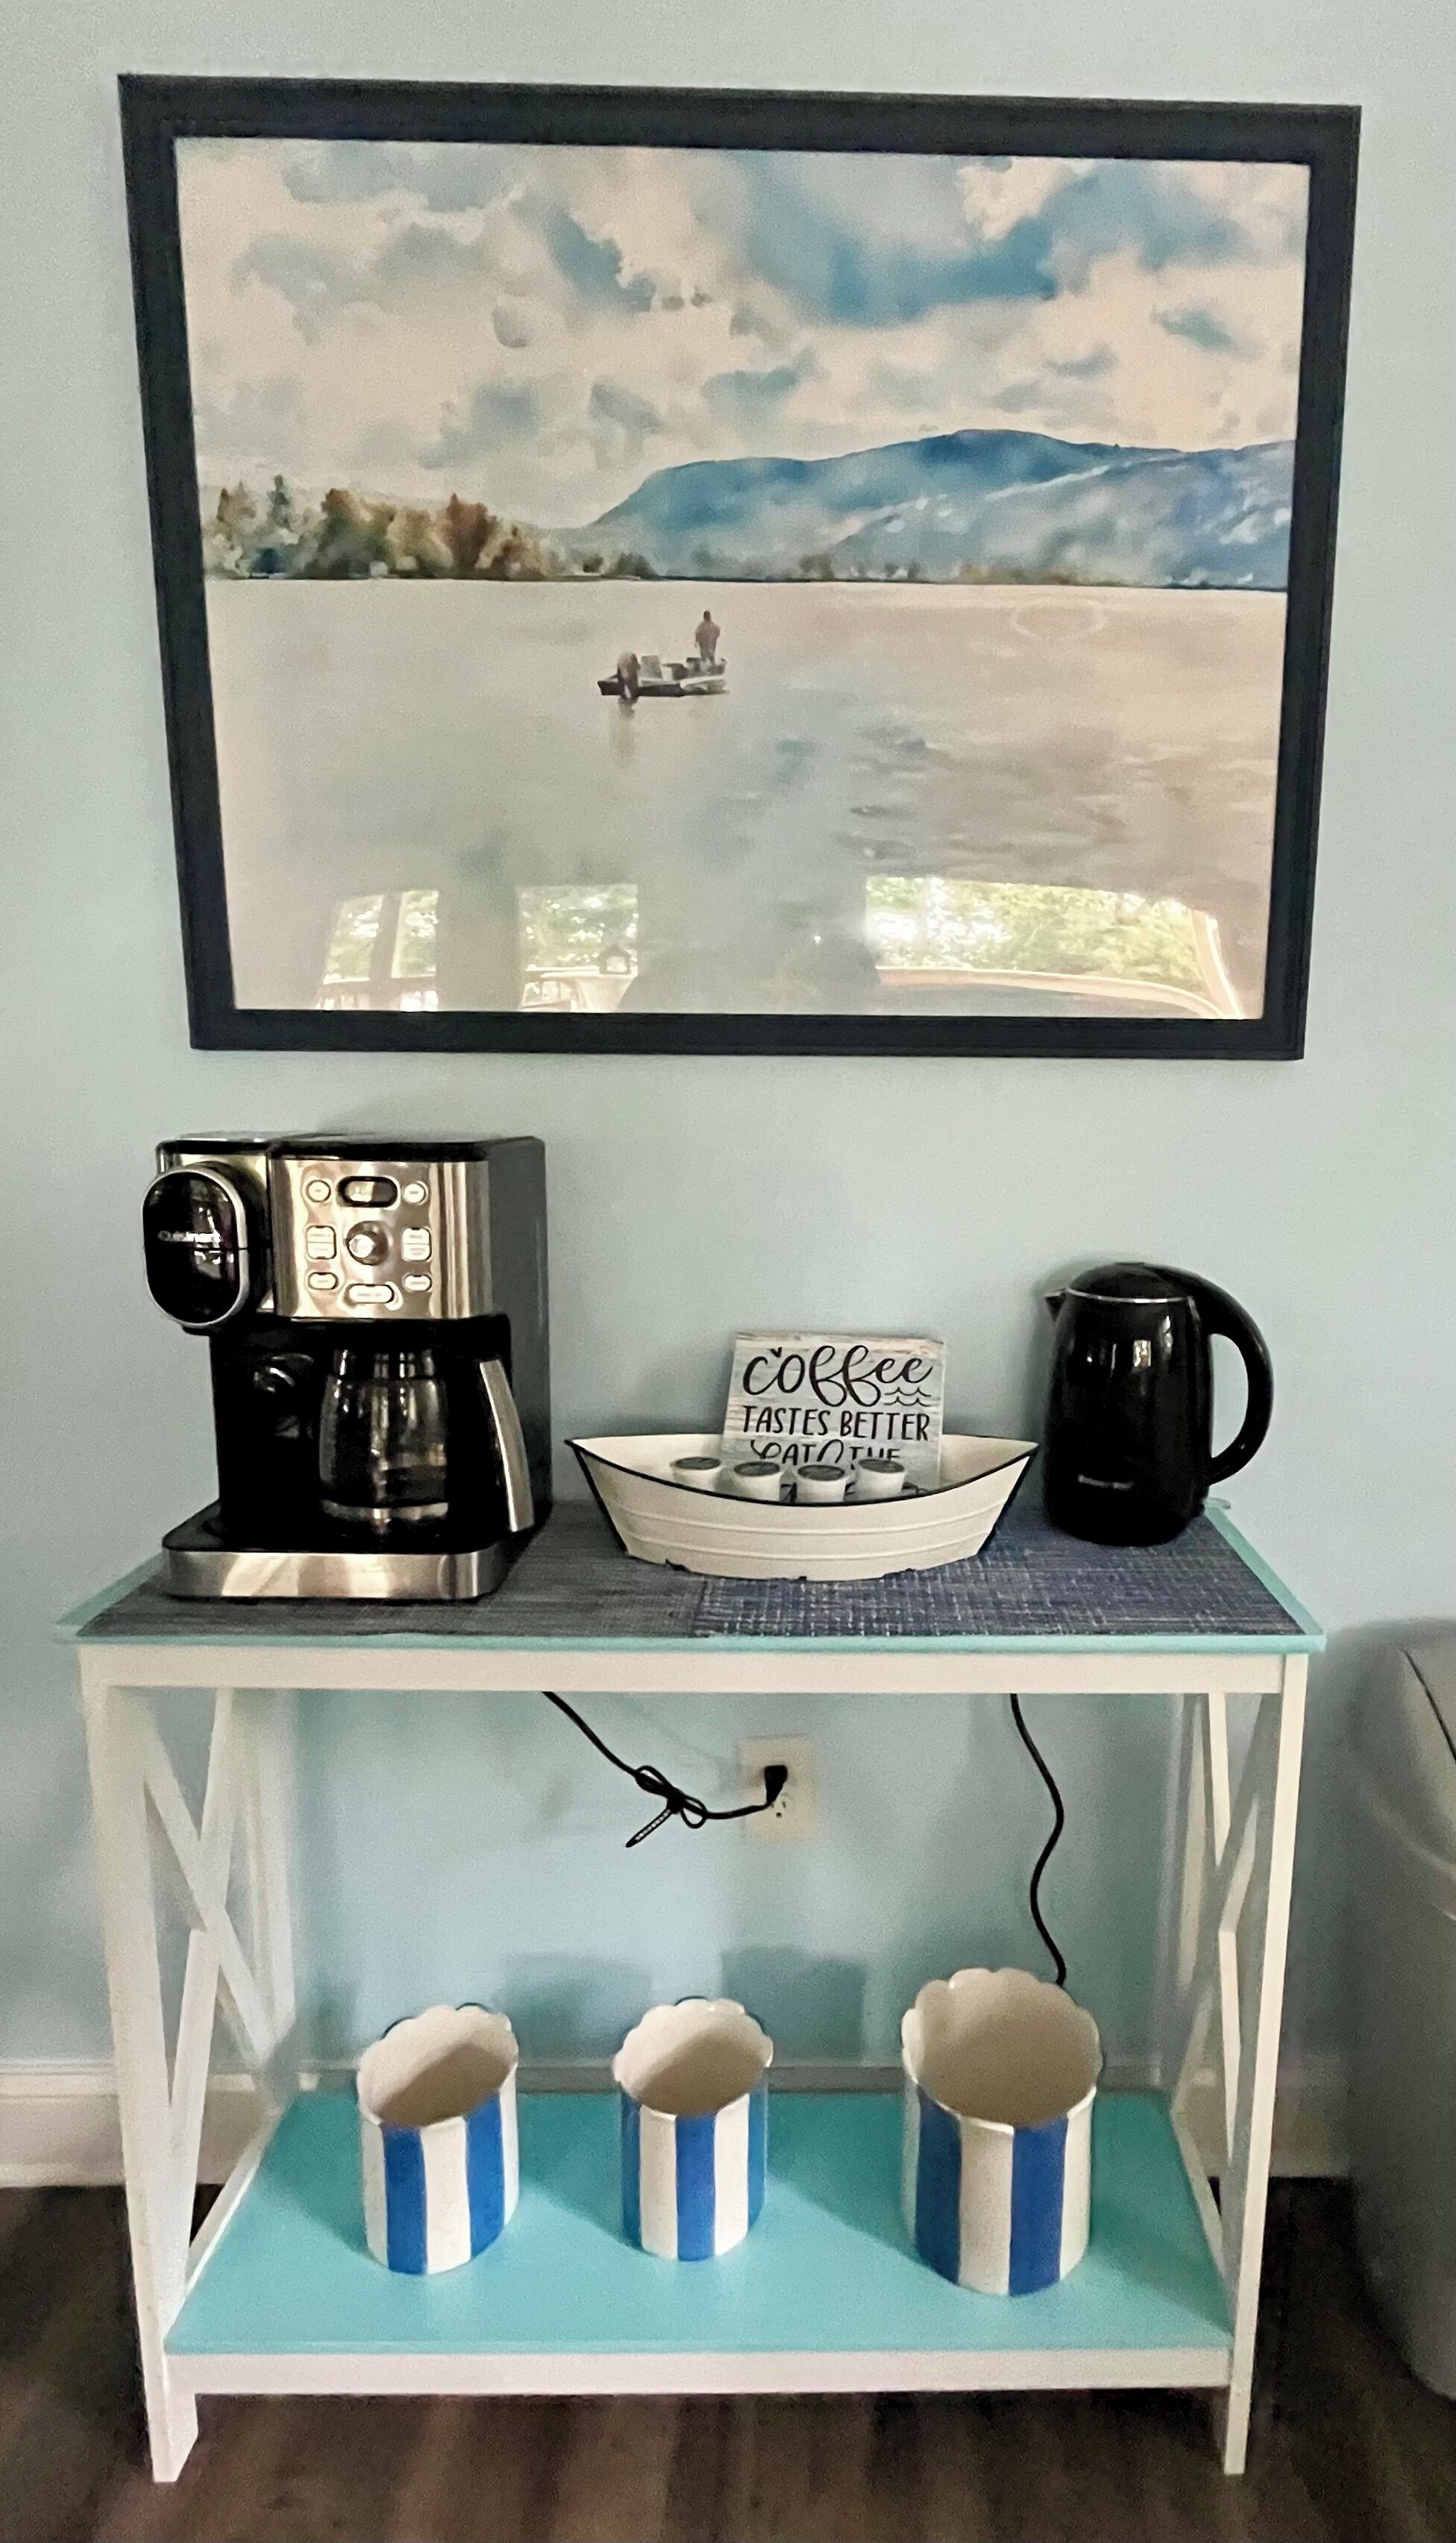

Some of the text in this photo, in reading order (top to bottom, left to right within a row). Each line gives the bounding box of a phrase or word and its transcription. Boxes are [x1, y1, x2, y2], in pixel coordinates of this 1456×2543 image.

[742, 1405, 930, 1441] TASTES BETTER
[782, 1443, 817, 1466] AT
